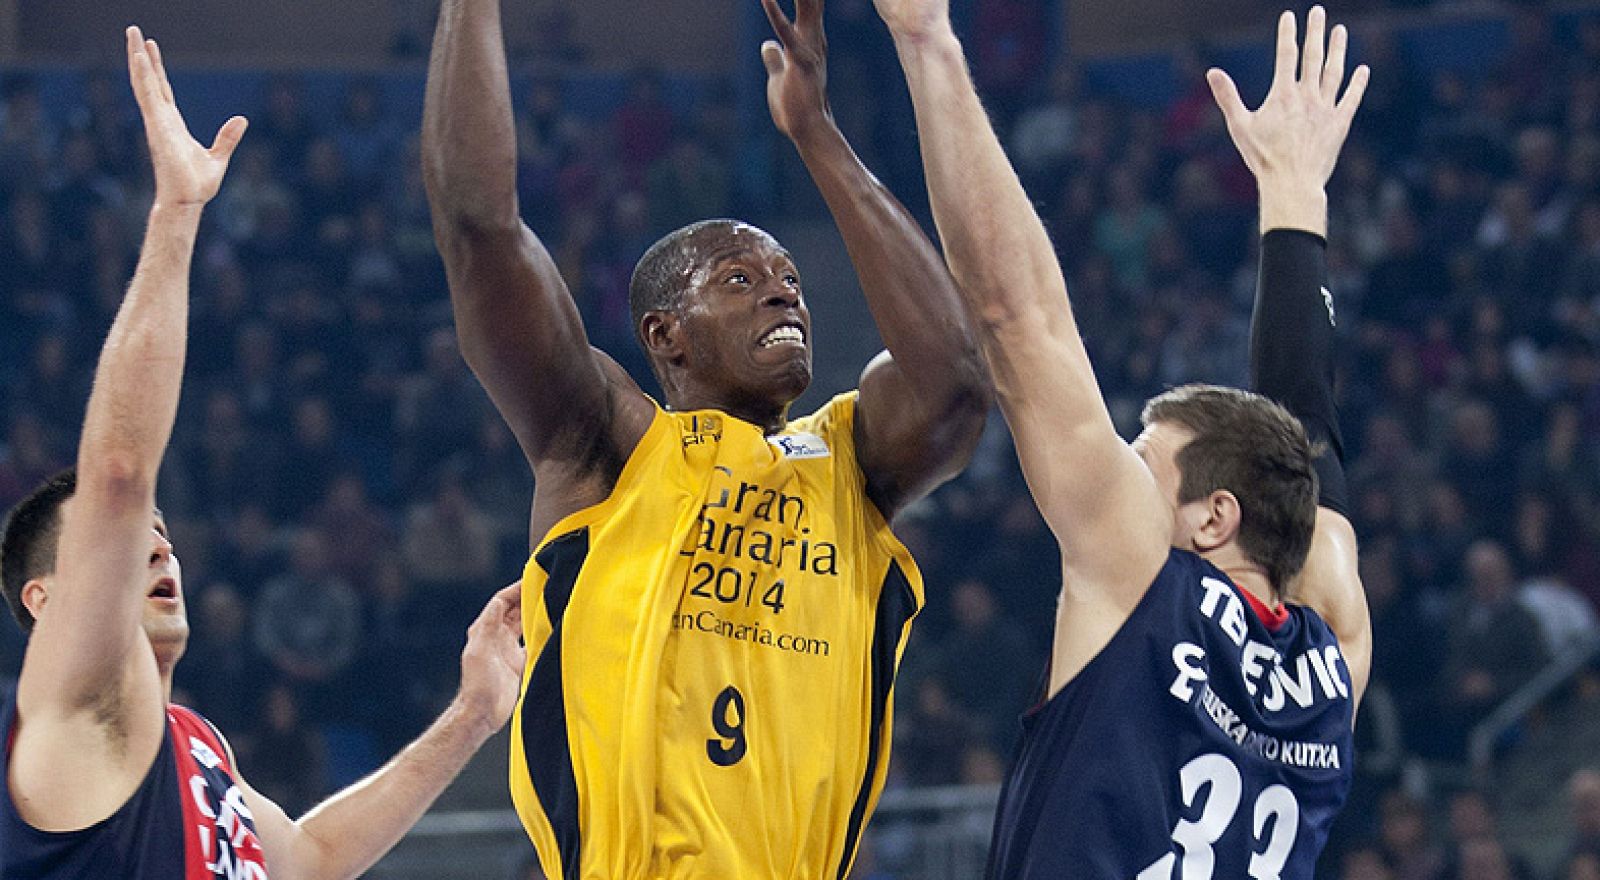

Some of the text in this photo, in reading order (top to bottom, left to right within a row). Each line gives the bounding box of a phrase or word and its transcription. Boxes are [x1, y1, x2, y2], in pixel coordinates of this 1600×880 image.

[680, 518, 838, 576] anaria
[690, 562, 785, 614] 2014
[706, 684, 747, 766] 9
[1281, 740, 1340, 769] KUTXA
